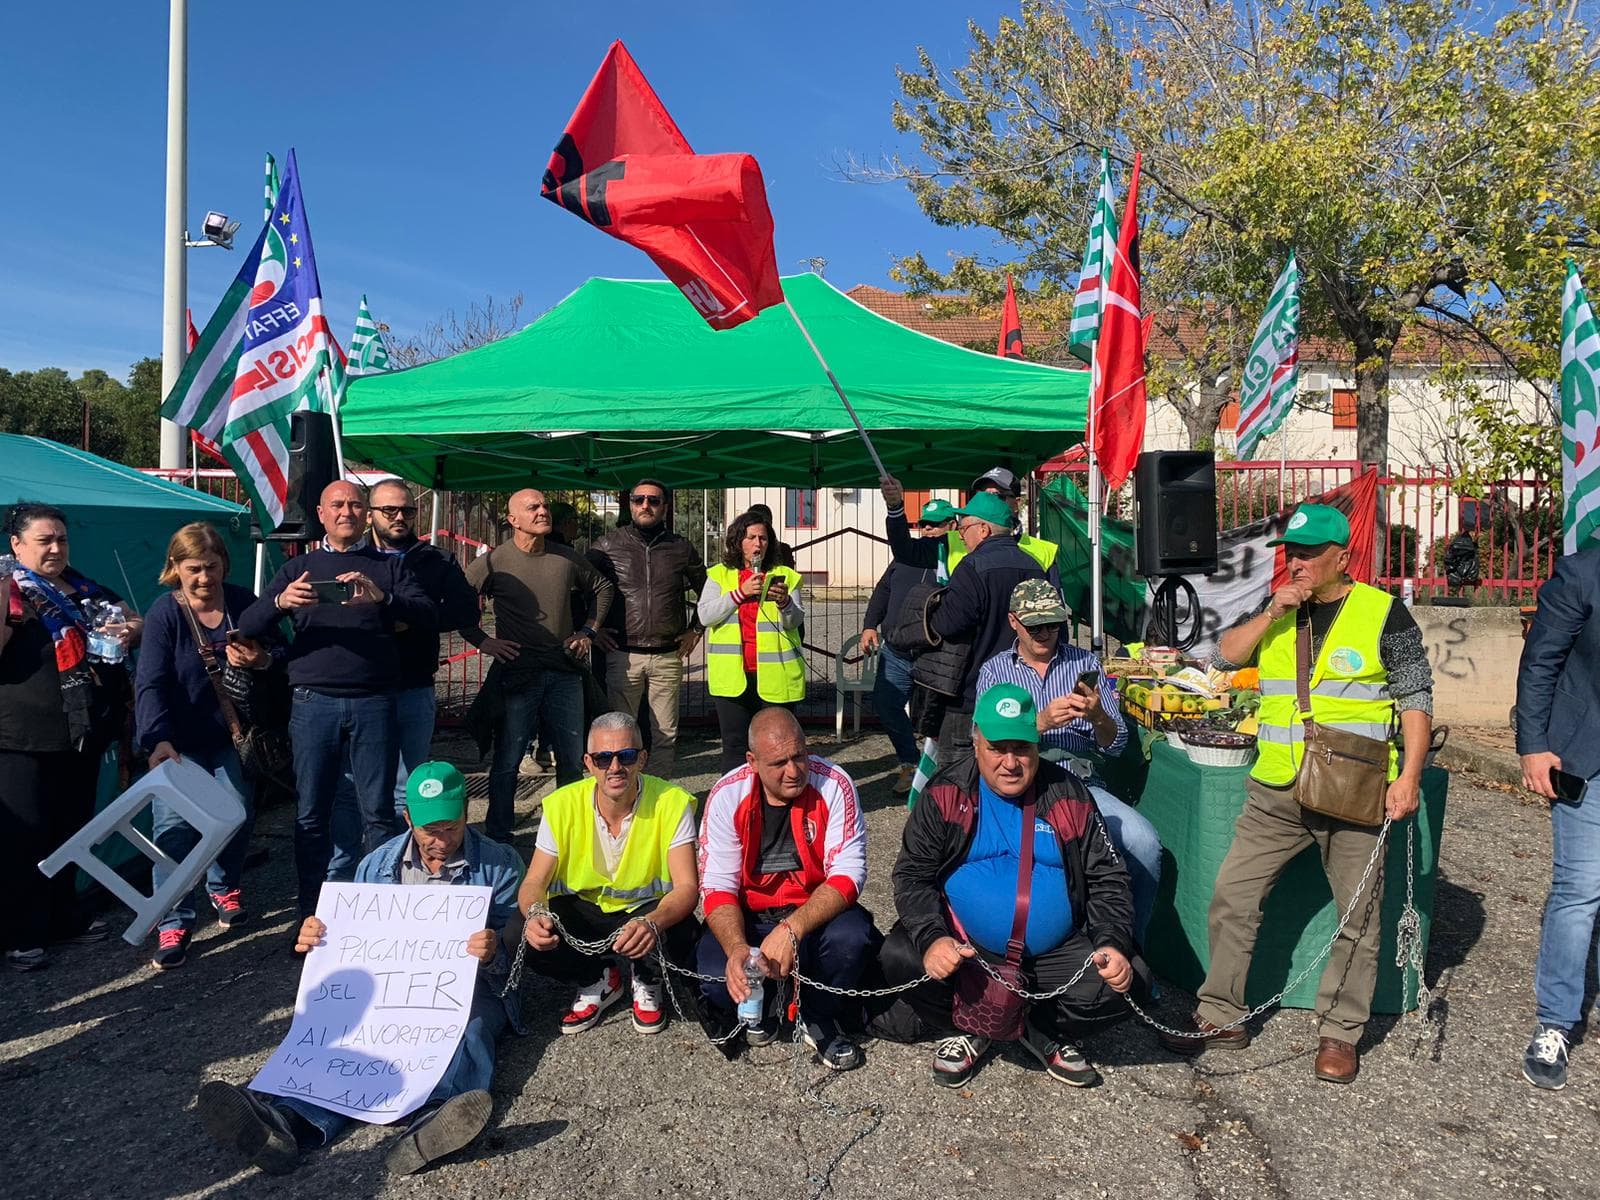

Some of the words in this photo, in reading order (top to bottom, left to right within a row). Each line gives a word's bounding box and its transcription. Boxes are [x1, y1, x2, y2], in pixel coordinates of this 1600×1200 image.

[333, 892, 487, 922] MANCATO
[339, 935, 471, 964] PAGAMENTO
[313, 983, 357, 1002] DEL
[374, 970, 464, 1009] TFR
[297, 1022, 327, 1047] AI
[339, 1023, 463, 1048] LAVORATORI
[283, 1053, 314, 1069] IN
[326, 1055, 438, 1078] PENSIONE
[282, 1075, 314, 1096] DA
[331, 1088, 410, 1109] ANNI
